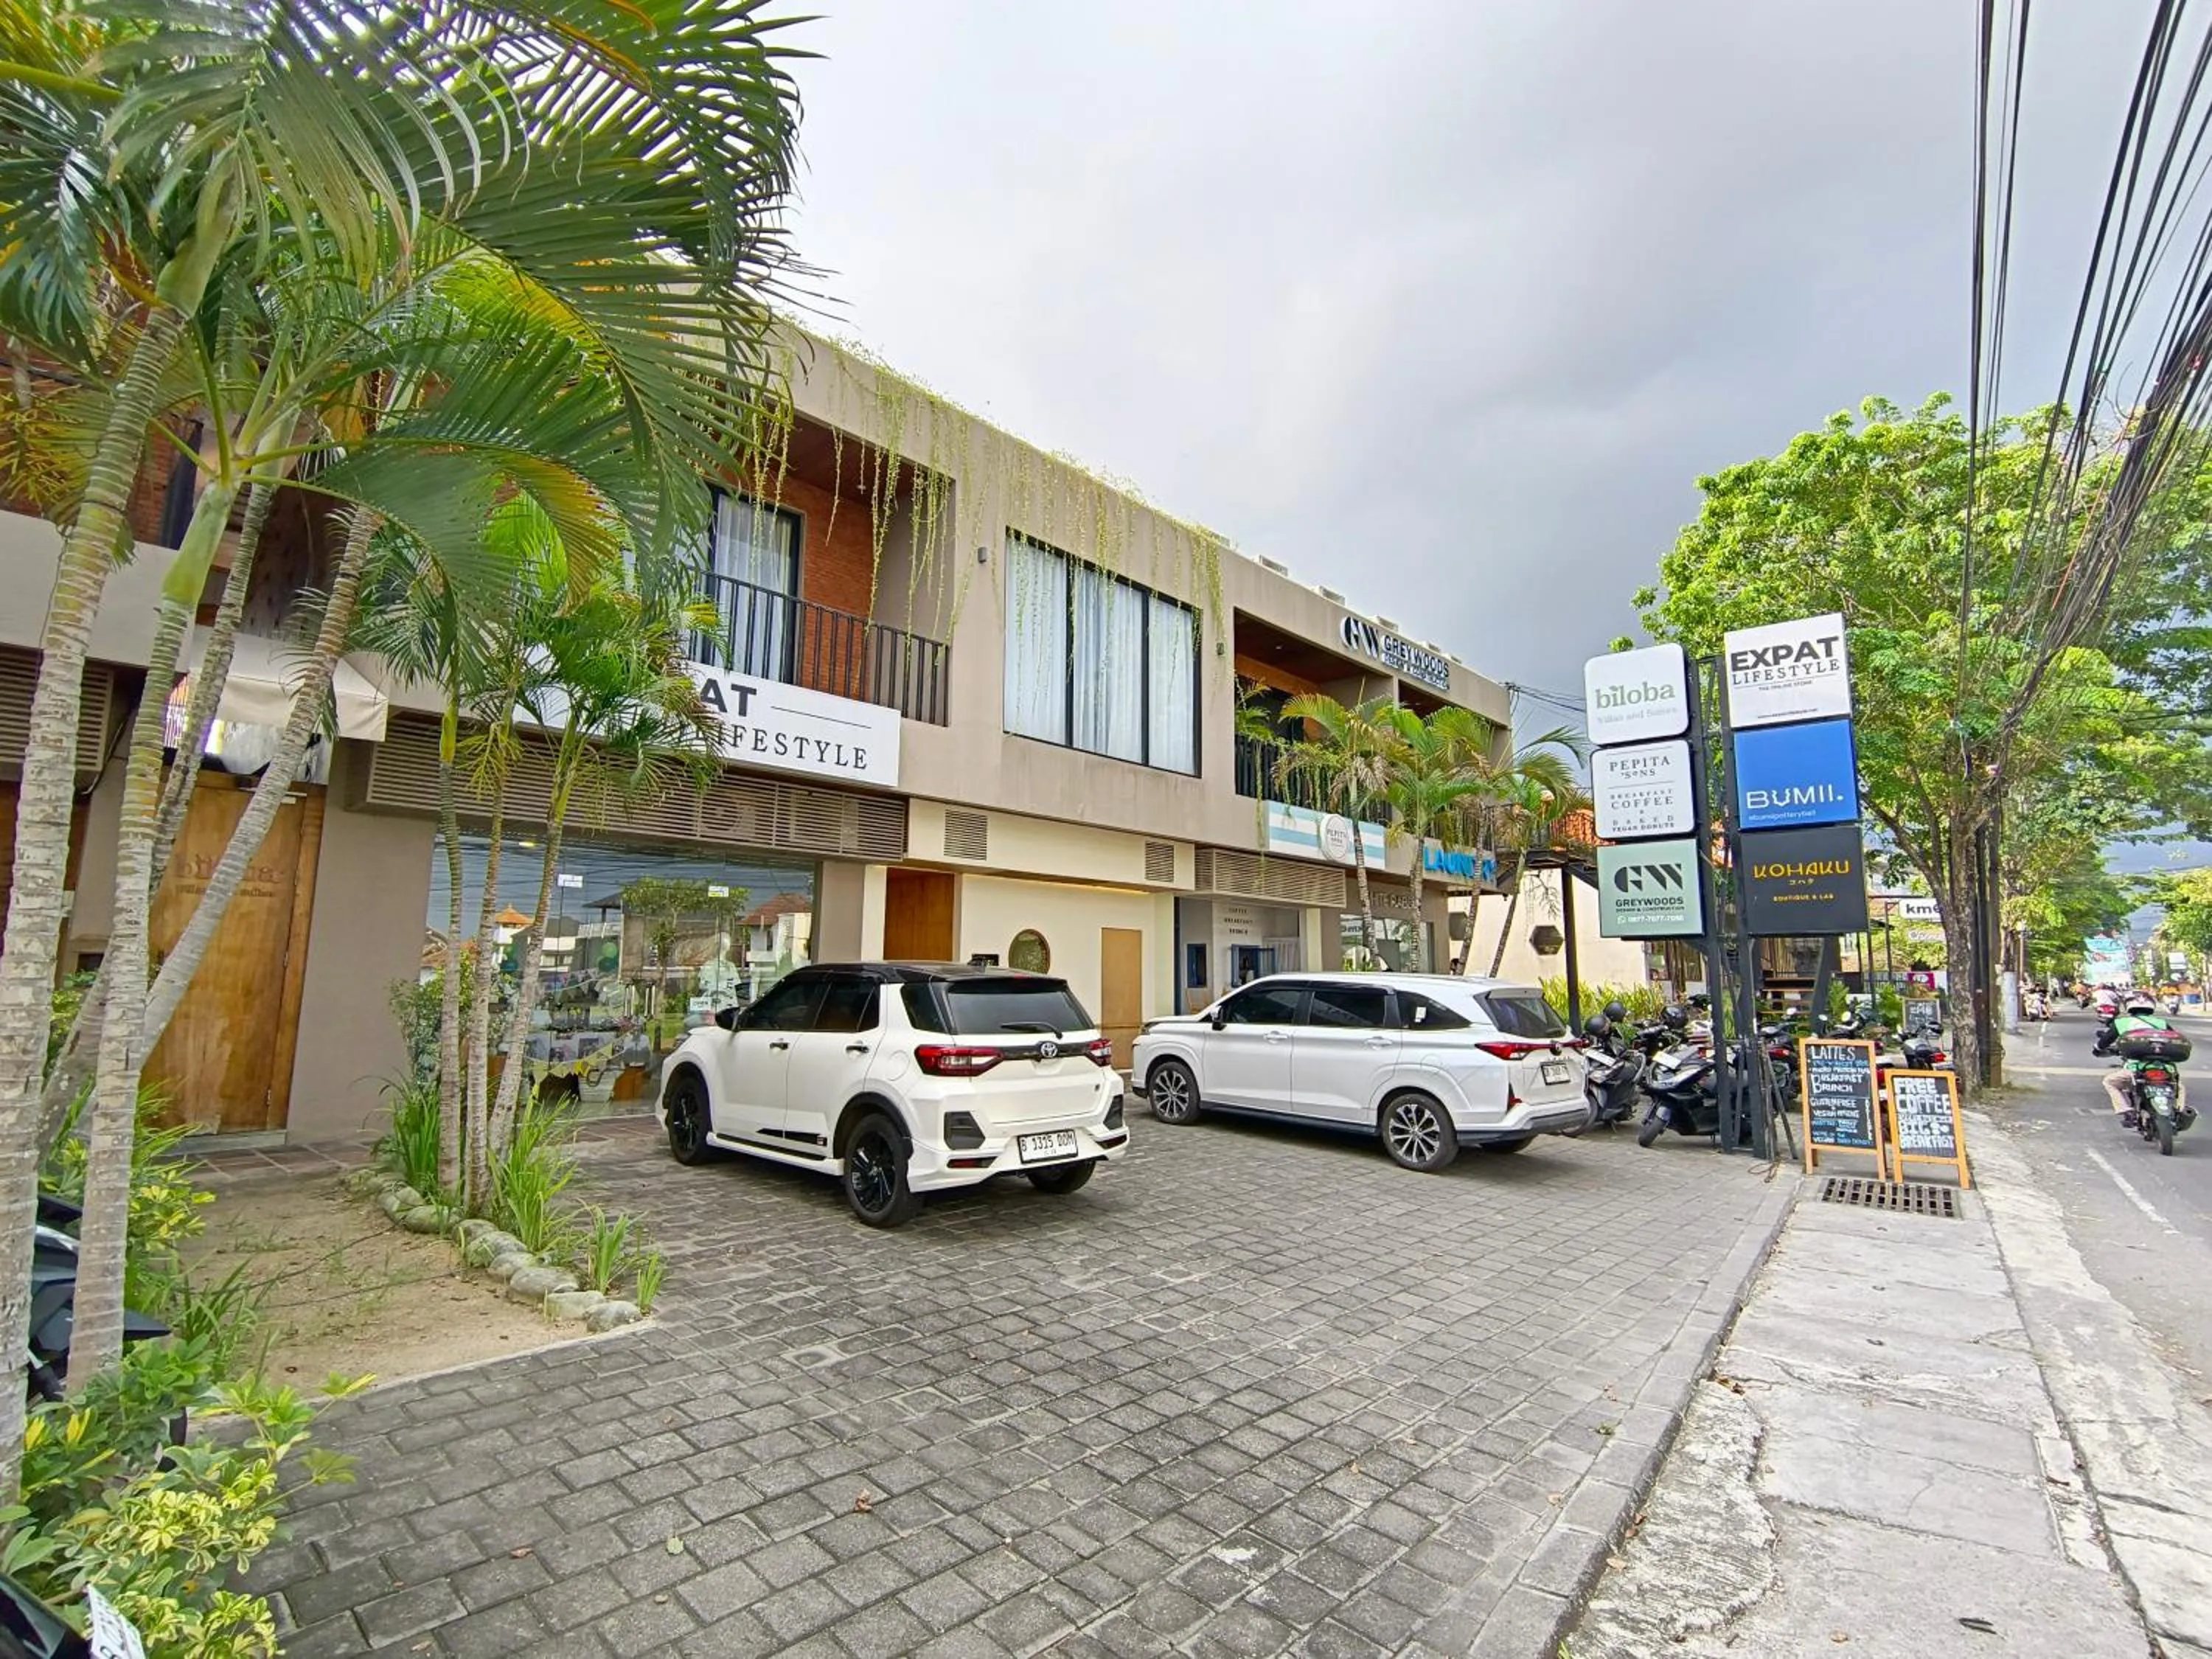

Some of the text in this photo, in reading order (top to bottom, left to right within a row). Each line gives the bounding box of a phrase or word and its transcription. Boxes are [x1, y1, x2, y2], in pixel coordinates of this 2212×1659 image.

[1731, 636, 1839, 672] EXPAT
[1733, 658, 1840, 685] LIFESTYLE
[1595, 681, 1676, 709] biloba
[712, 720, 868, 770] IFESTYLE
[1610, 756, 1670, 772] PEPITA
[1611, 796, 1673, 810] COFFEE
[1614, 863, 1683, 893] GW
[1753, 859, 1850, 879] KOHAKU
[1615, 896, 1684, 908] GREYWOODS
[1893, 1077, 1938, 1094] FREE
[1896, 1093, 1952, 1114] COFFEE
[1898, 1120, 1931, 1135] BIG
[1899, 1135, 1955, 1148] BREAKFAST
